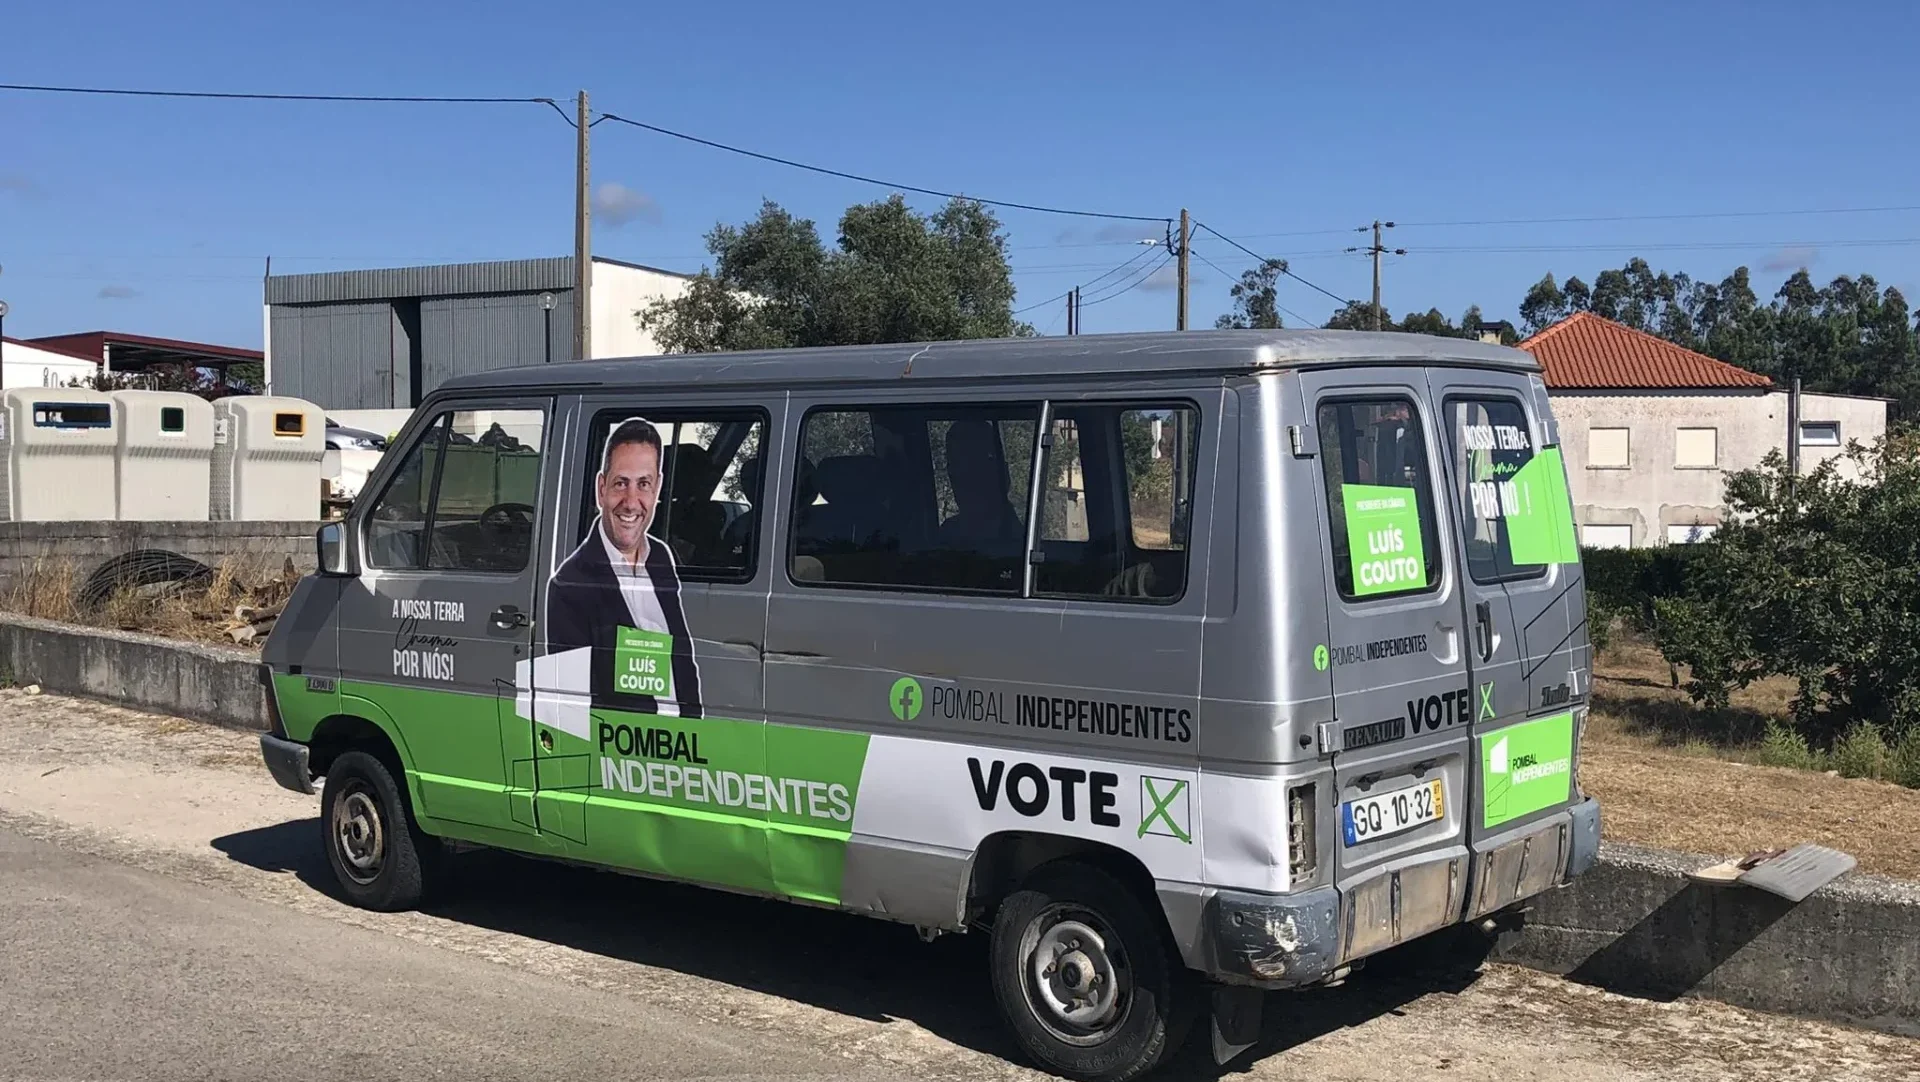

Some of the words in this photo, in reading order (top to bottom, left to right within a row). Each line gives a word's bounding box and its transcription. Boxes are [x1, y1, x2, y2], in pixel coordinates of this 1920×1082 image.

[1463, 425, 1497, 450] NOSSA
[1494, 425, 1530, 450] TERRA
[1469, 481, 1500, 518] POR
[1368, 523, 1404, 555] LUÍS
[1360, 556, 1419, 587] COUTO
[392, 599, 399, 618] A
[400, 599, 431, 620] NOSSA
[434, 601, 465, 622] TERRA
[393, 648, 419, 678] POR
[422, 647, 454, 681] NÓS!
[629, 655, 656, 674] LUÍS
[1332, 645, 1366, 666] POMBAL
[1366, 634, 1428, 661] INDEPENDENTES
[620, 674, 665, 692] COUTO
[932, 685, 1009, 725] POMBAL
[1015, 694, 1192, 743] INDEPENDENTES
[1407, 688, 1469, 734] VOTE
[600, 722, 708, 764] POMBAL
[1344, 719, 1405, 749] RENAULT
[1512, 754, 1538, 771] POMBAL
[600, 757, 852, 822] INDEPENDENTES
[967, 757, 1120, 828] VOTE
